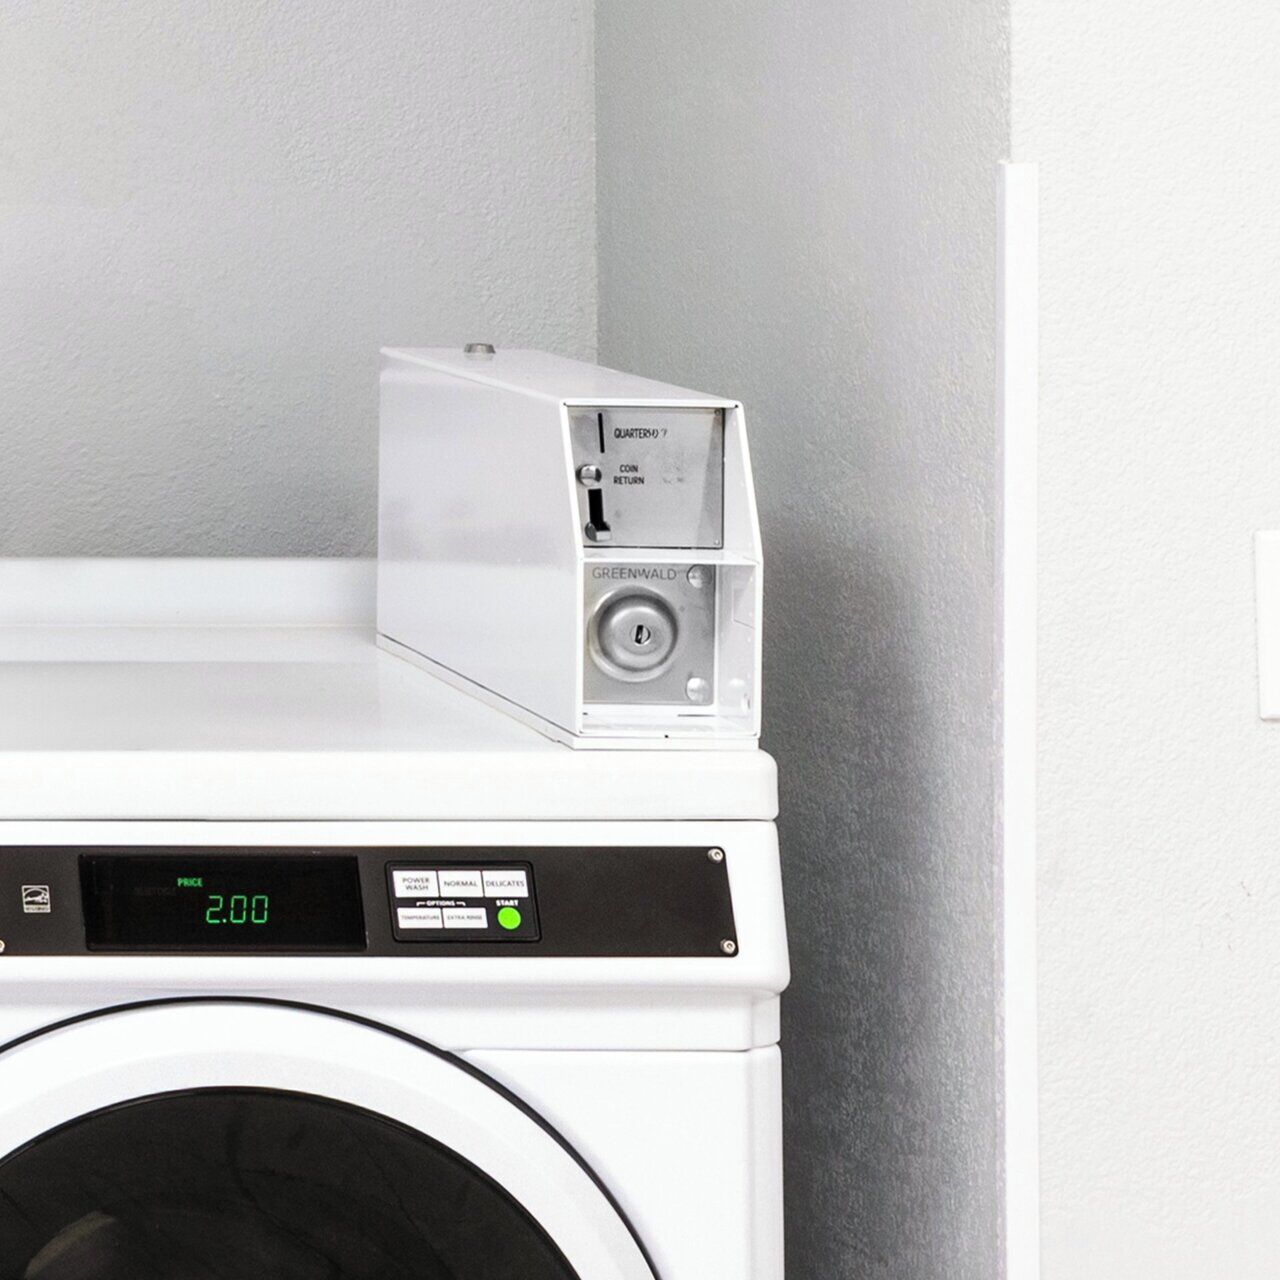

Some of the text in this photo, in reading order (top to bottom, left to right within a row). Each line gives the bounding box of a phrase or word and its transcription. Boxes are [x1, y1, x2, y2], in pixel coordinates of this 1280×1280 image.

[619, 464, 639, 474] COIN
[613, 475, 645, 485] RETURN
[591, 566, 678, 581] GREENWALD
[177, 877, 204, 888] PRICE
[443, 880, 479, 888] NORMAL
[485, 880, 525, 888] DELICATES
[495, 899, 520, 907] START
[205, 895, 269, 924] 2.00
